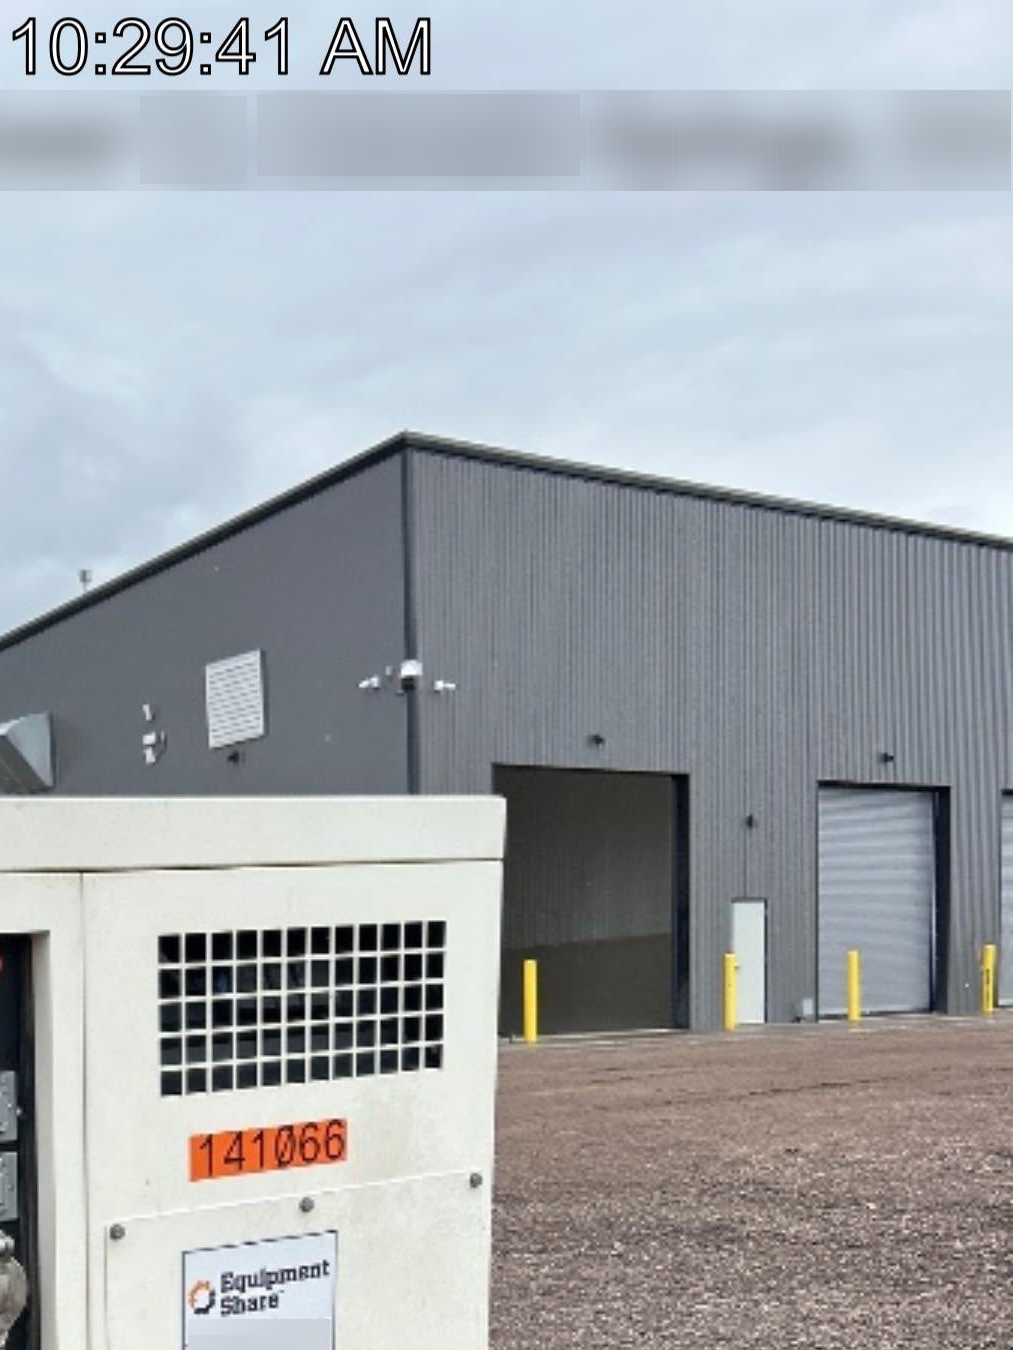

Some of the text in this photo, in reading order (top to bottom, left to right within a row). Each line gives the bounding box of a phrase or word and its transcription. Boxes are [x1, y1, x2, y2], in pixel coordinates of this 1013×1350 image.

[198, 1118, 345, 1177] 141066
[220, 1259, 330, 1294] Equipment
[220, 1292, 279, 1317] Share
